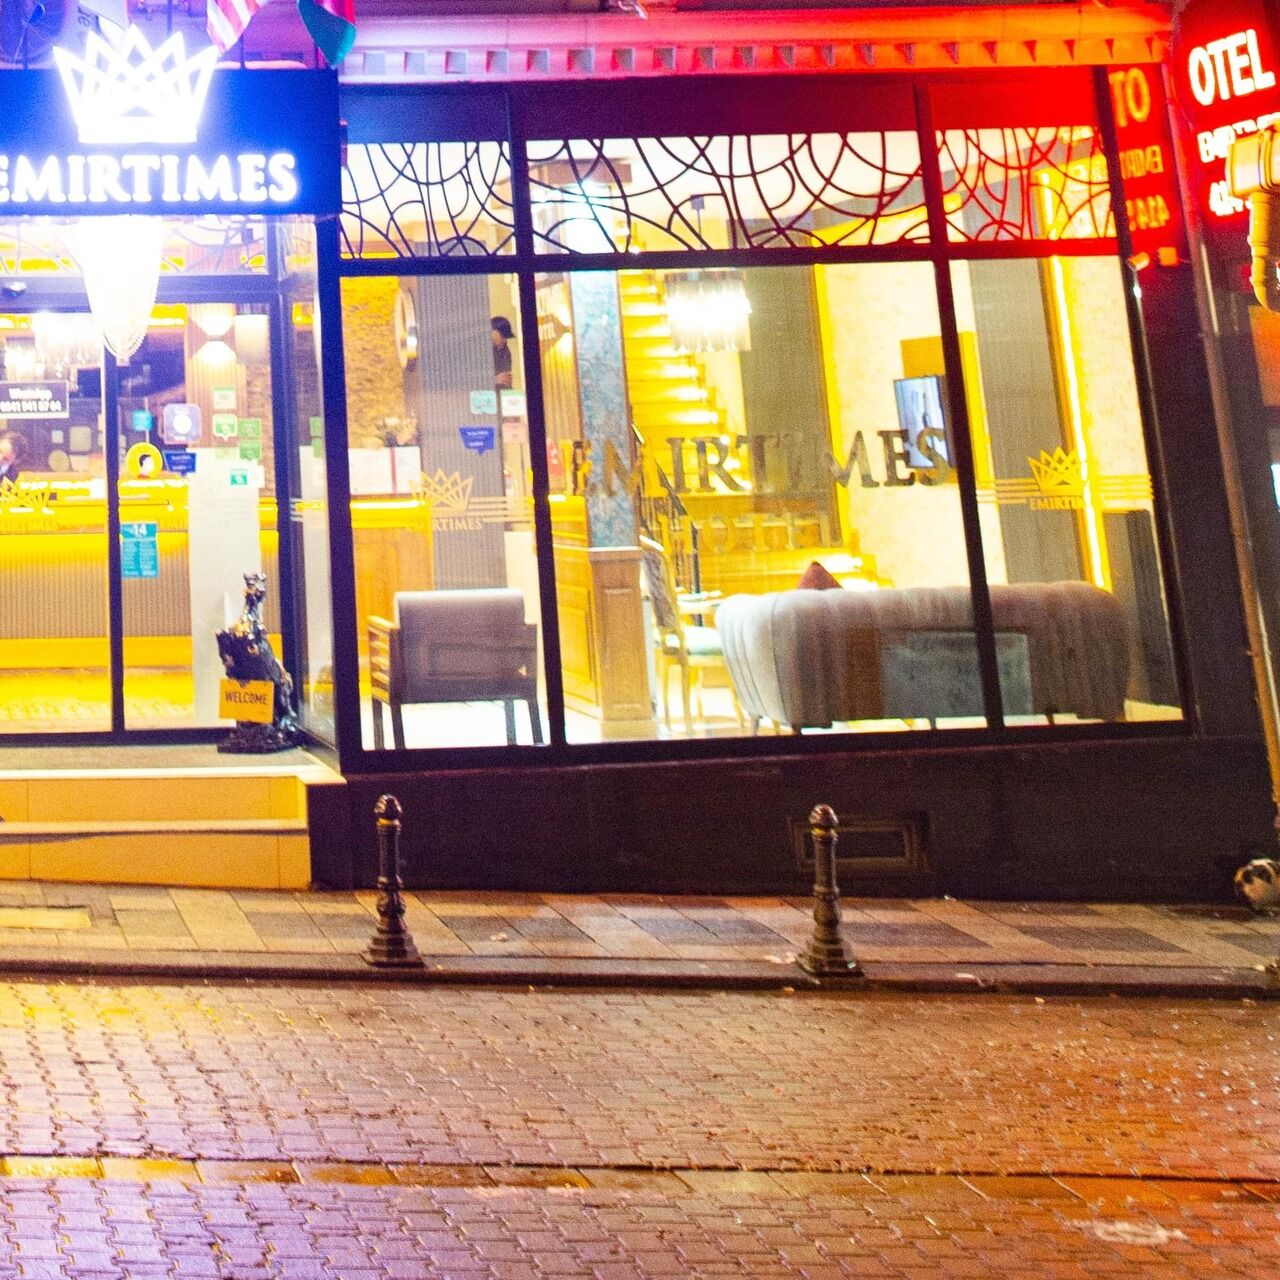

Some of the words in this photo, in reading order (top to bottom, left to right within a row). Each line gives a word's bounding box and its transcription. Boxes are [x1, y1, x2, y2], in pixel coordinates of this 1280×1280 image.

[1188, 29, 1276, 106] OTEL
[560, 426, 952, 497] EMIRTIMES
[660, 512, 844, 554] HOTEL
[224, 690, 268, 706] WELCOME
